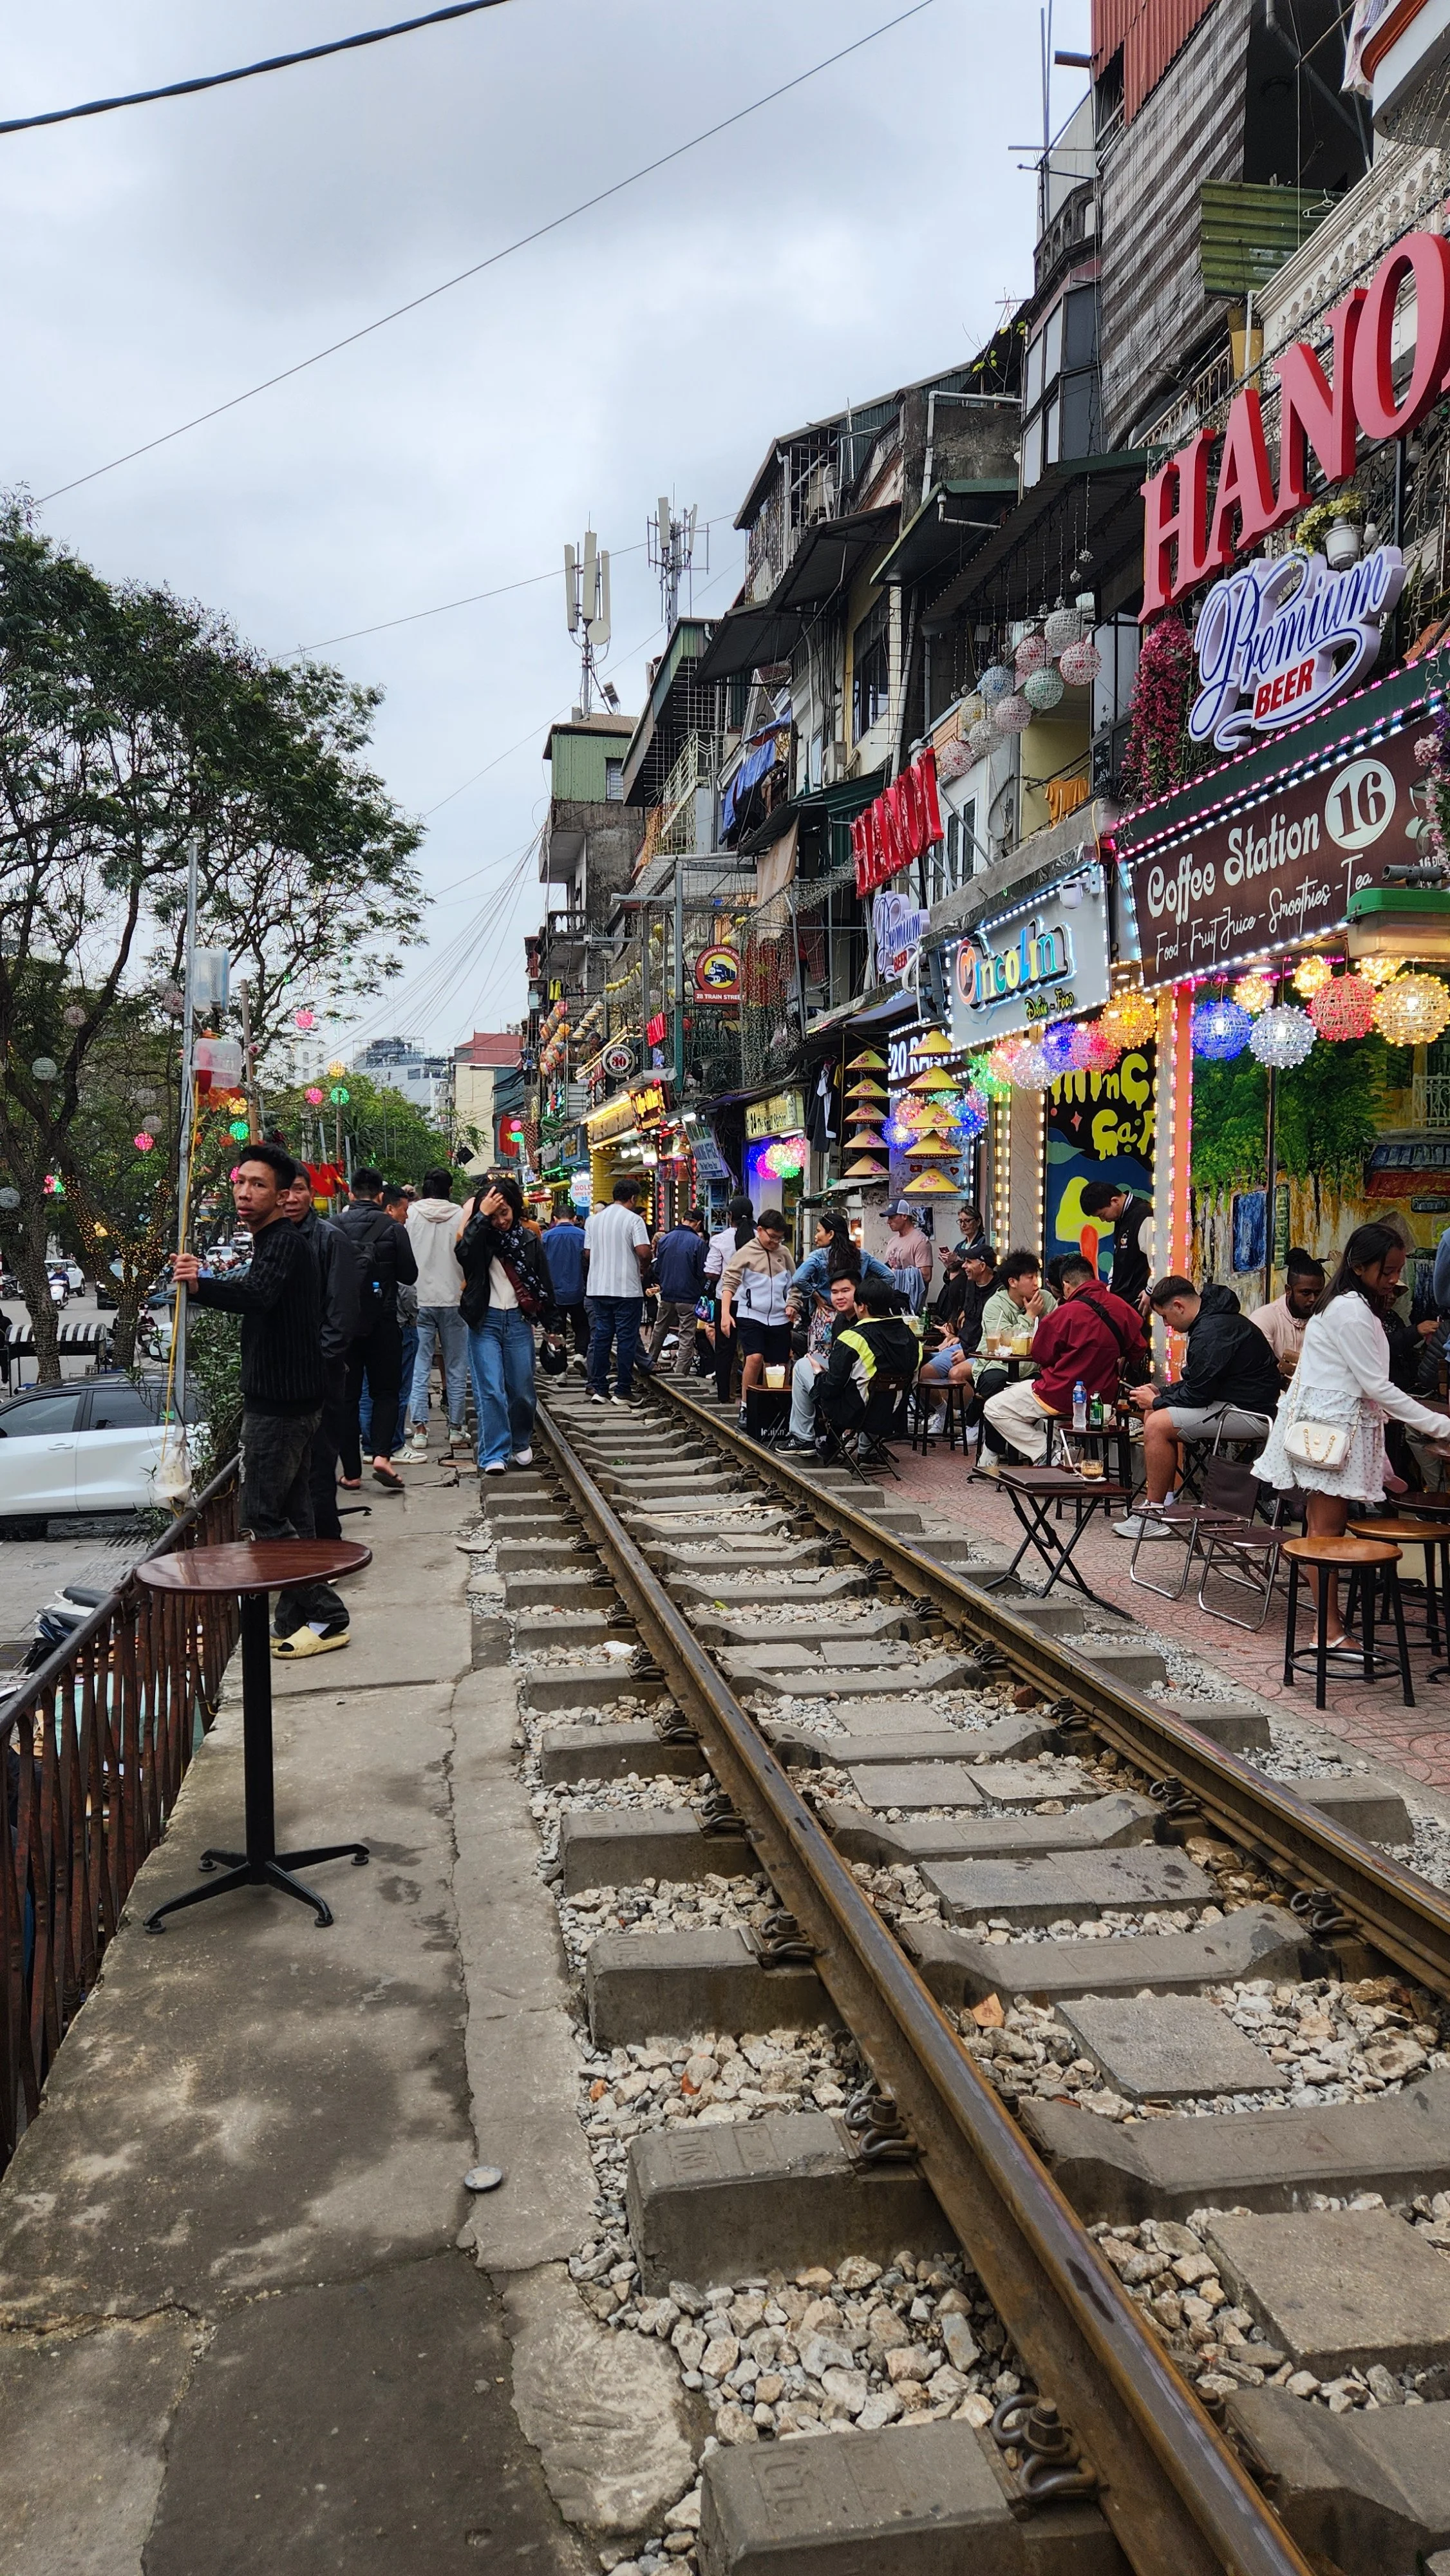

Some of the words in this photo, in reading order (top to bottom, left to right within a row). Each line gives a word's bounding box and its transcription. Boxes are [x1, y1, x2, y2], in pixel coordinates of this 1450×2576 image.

[1138, 196, 1450, 625] HANO
[1190, 553, 1389, 737] Premium
[1254, 658, 1315, 720] BEER
[1147, 853, 1216, 925] Coffee
[1223, 812, 1321, 887] Station
[1333, 771, 1387, 839] 16
[1156, 926, 1180, 974] Food
[1191, 914, 1227, 964] Fruit
[1220, 906, 1256, 951] Juice
[1268, 875, 1331, 935] Smoothies
[1340, 853, 1373, 908] Tea
[612, 1056, 626, 1067] 30
[890, 1041, 907, 1081] 20
